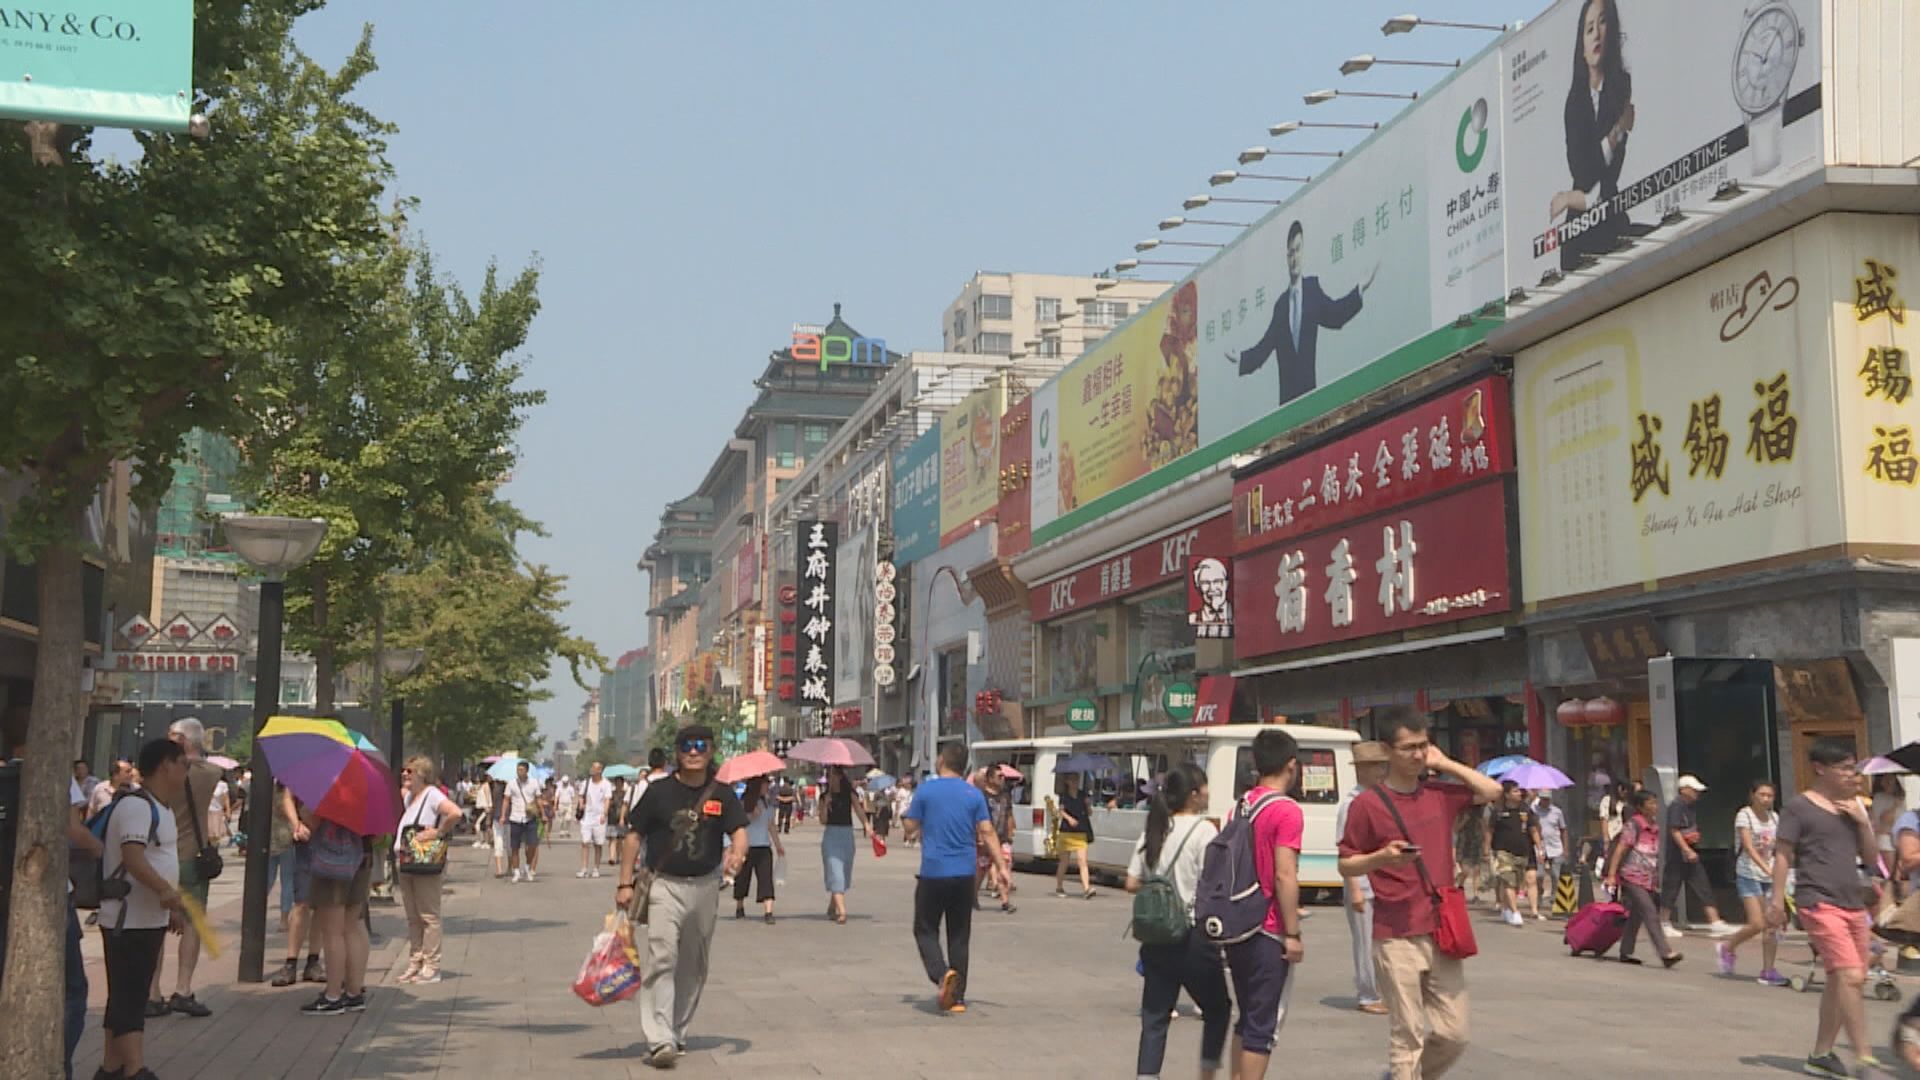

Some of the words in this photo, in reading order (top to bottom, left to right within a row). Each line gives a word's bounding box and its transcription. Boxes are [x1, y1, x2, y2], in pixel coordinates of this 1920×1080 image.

[61, 12, 84, 36] &
[1558, 201, 1609, 243] TISSOT
[1612, 187, 1638, 213] THIS
[1641, 178, 1652, 200] IS
[1654, 157, 1691, 192] YOUR
[1694, 136, 1728, 171] TIME
[1447, 212, 1476, 237] CHINA
[1478, 197, 1500, 219] LIFE
[790, 333, 887, 372] apm
[1763, 481, 1803, 509] Shop
[1050, 575, 1077, 612] KFC
[1100, 556, 1132, 596] 肯德基
[1160, 529, 1198, 576] KFC
[1274, 520, 1417, 634] 稻香村
[1195, 704, 1218, 724] KFC
